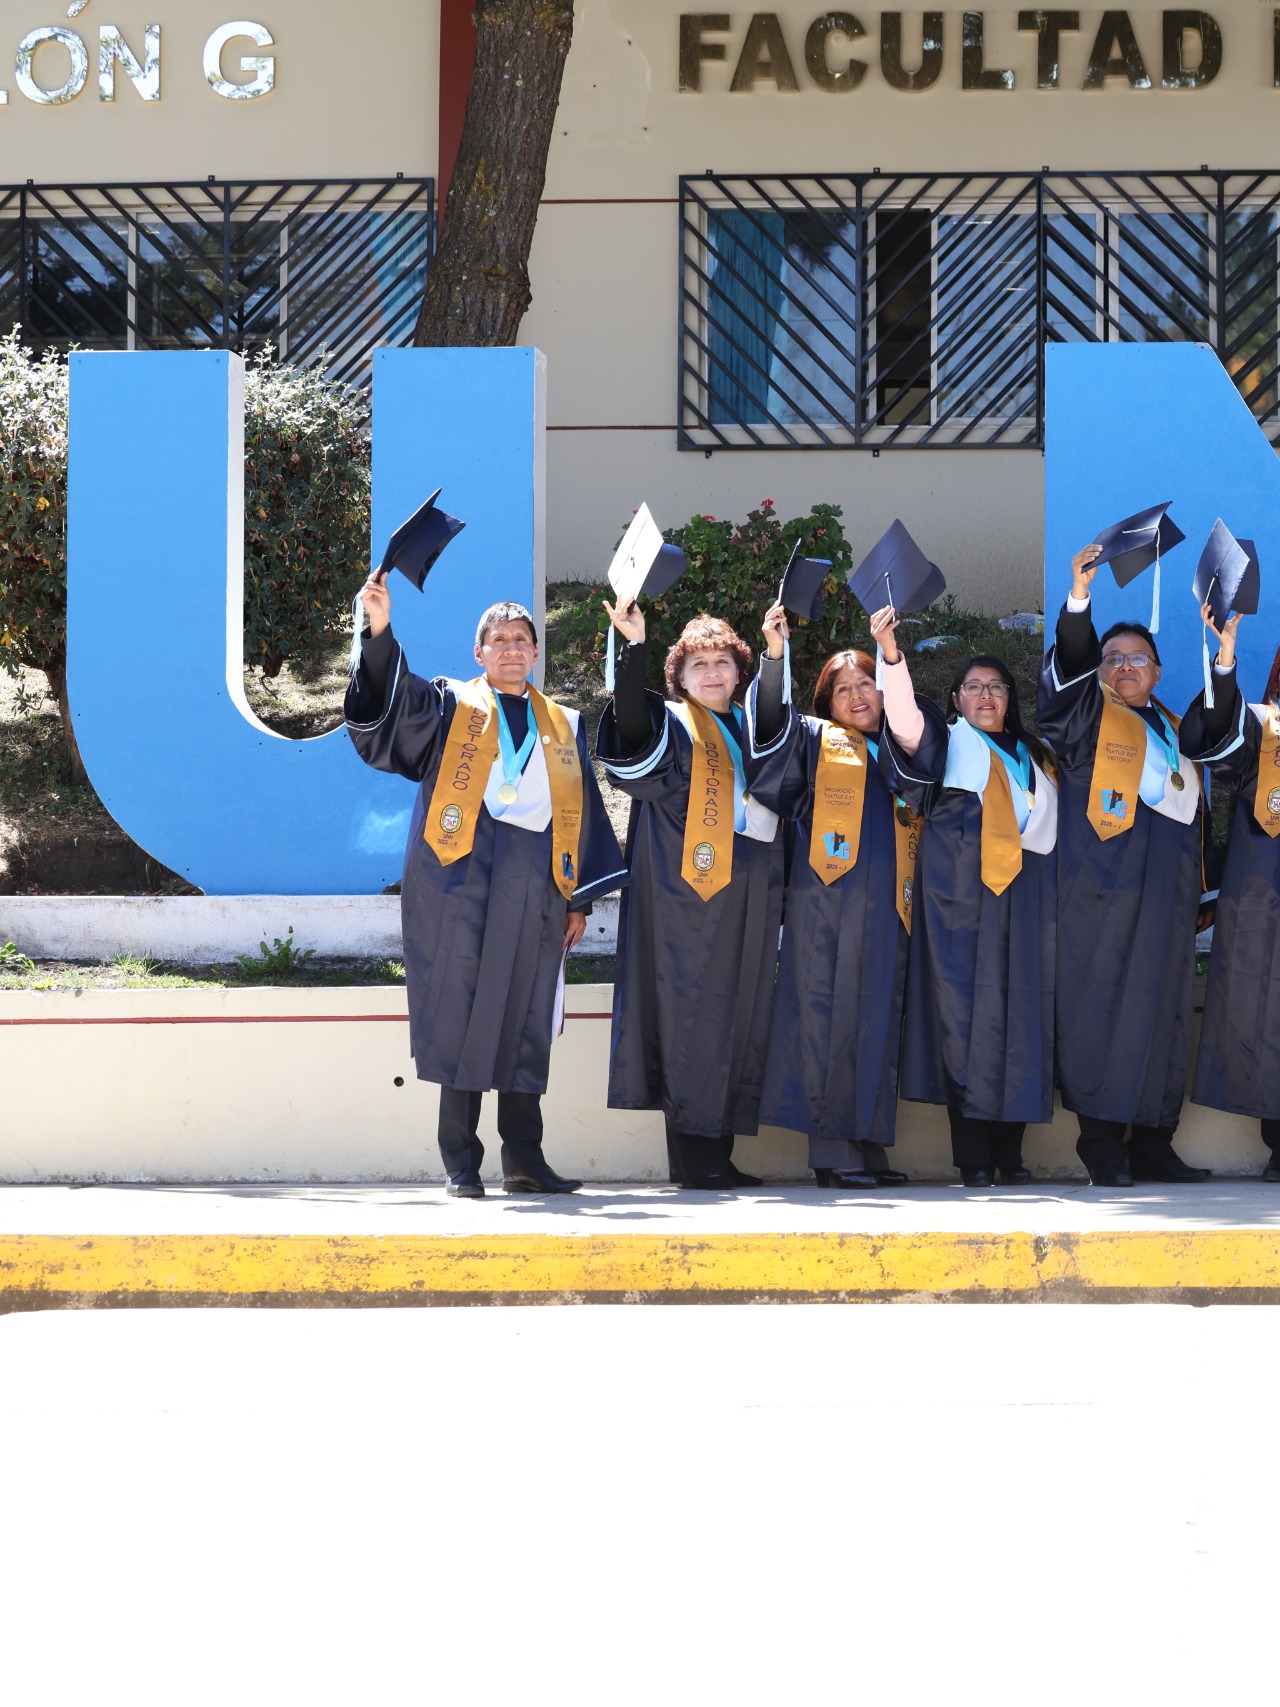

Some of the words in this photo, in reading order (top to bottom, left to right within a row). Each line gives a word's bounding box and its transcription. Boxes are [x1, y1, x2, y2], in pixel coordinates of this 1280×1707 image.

[0, 0, 161, 104] ÓN
[202, 21, 275, 99] G
[678, 9, 1222, 93] FACULTAD
[452, 707, 487, 790] DOCTORADO
[703, 741, 719, 827] DOCTORADO
